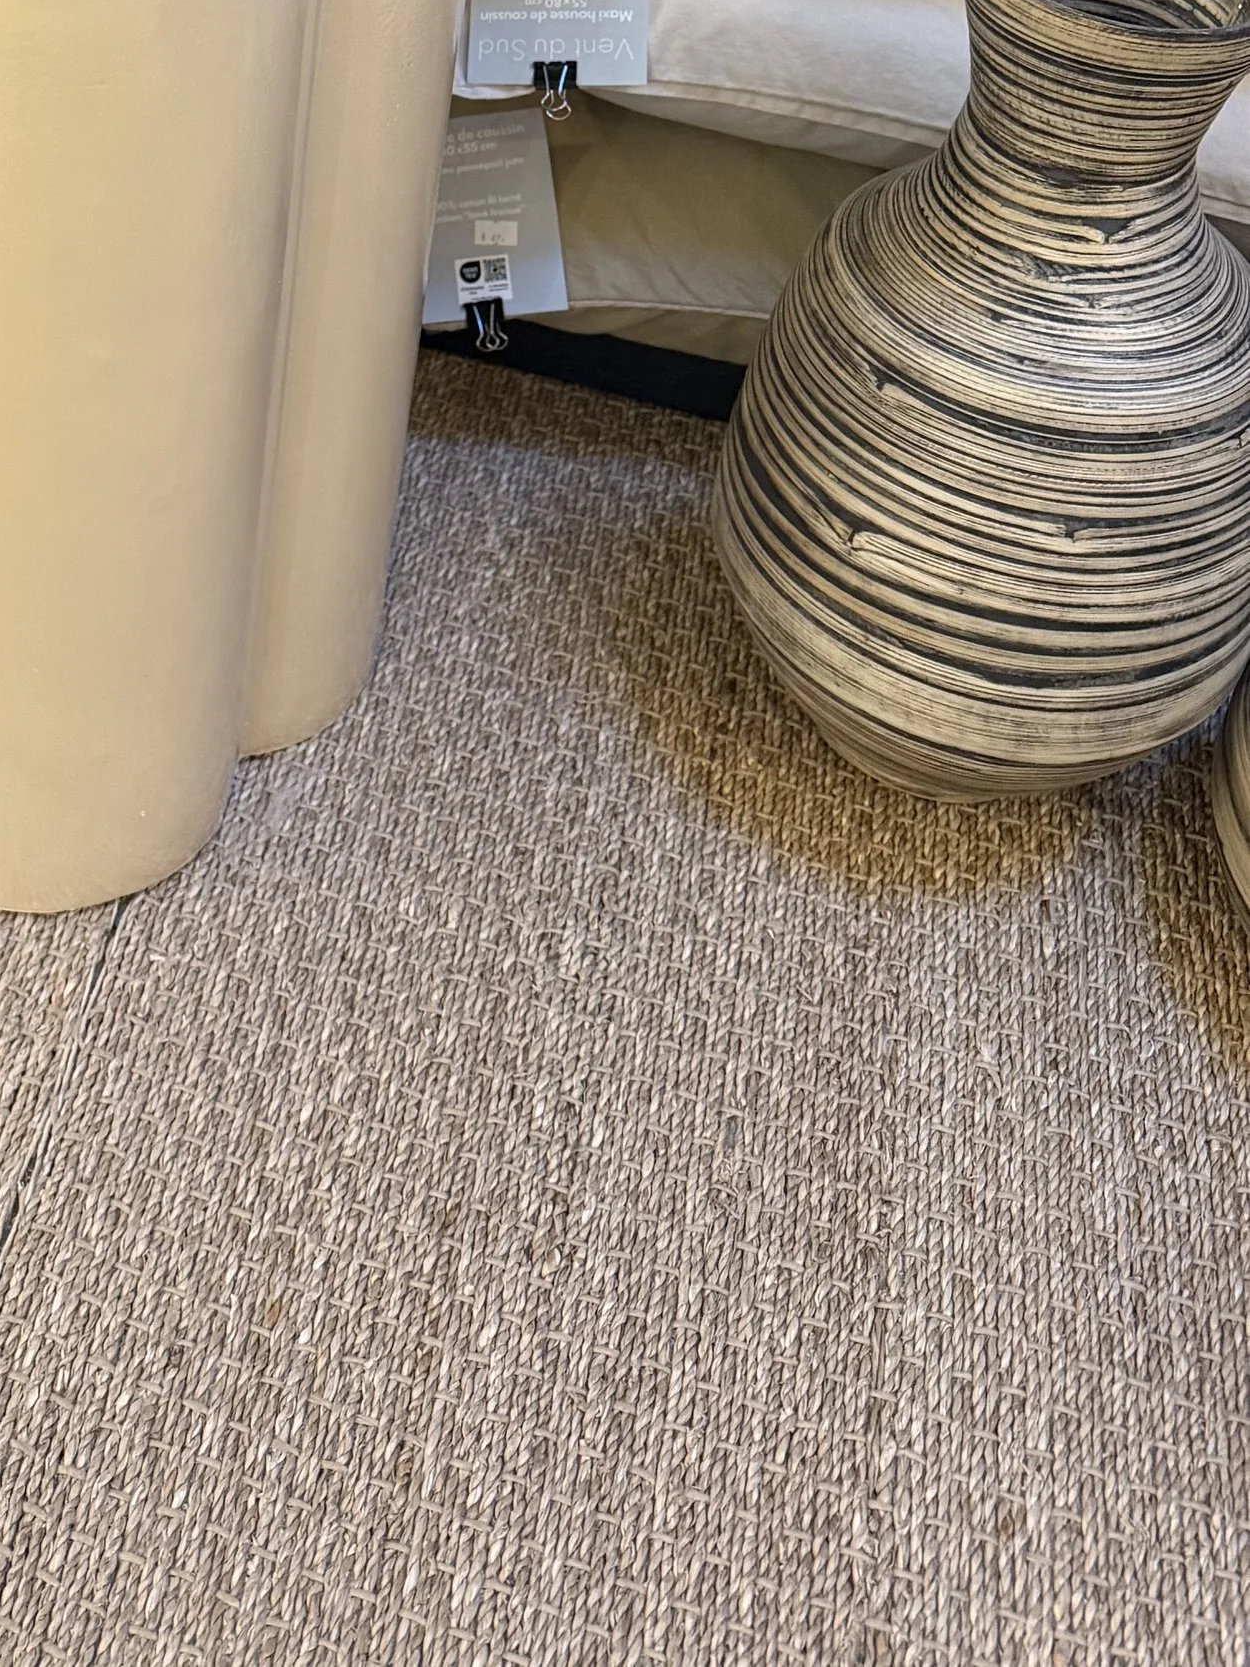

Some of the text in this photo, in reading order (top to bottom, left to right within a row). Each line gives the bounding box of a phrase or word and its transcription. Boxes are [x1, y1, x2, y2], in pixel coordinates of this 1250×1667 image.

[480, 10, 633, 23] Maxi housse de coussin
[478, 38, 634, 61] Vent du Sud
[458, 129, 474, 141] de
